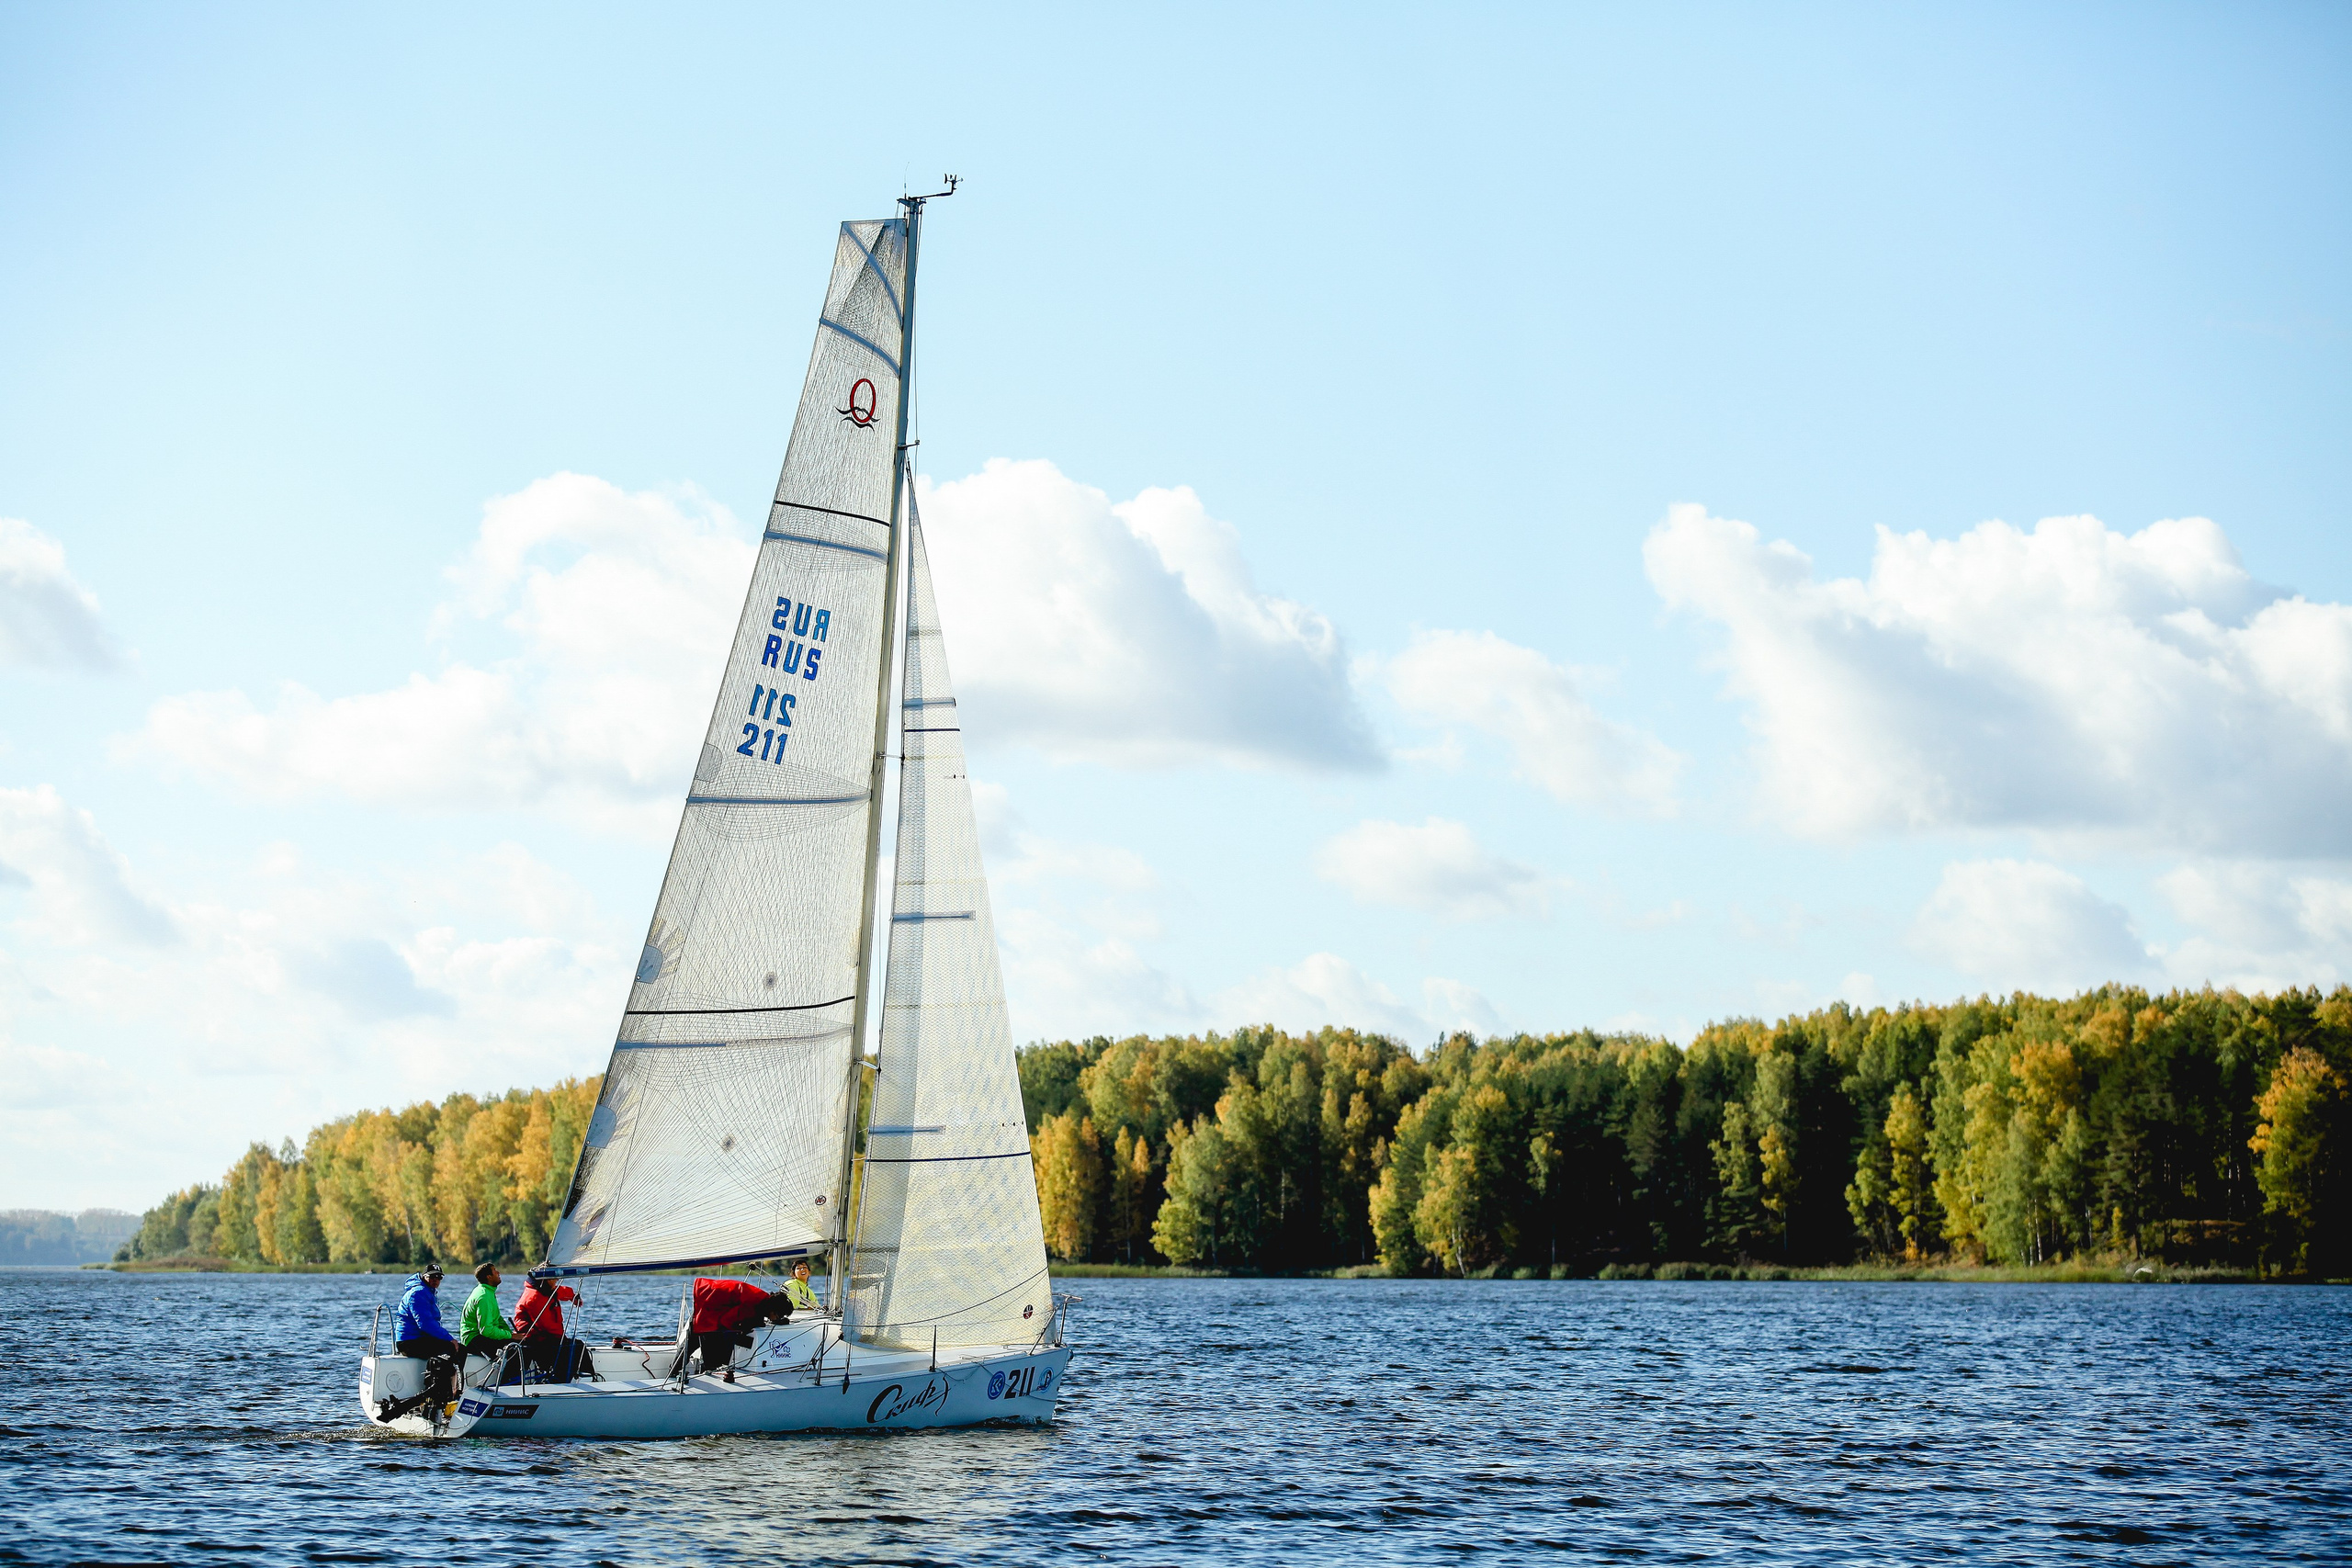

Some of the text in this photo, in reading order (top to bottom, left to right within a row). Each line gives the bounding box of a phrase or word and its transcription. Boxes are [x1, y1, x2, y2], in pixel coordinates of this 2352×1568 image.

[762, 634, 821, 681] RUS
[736, 722, 788, 765] 211
[1004, 1366, 1035, 1399] 211
